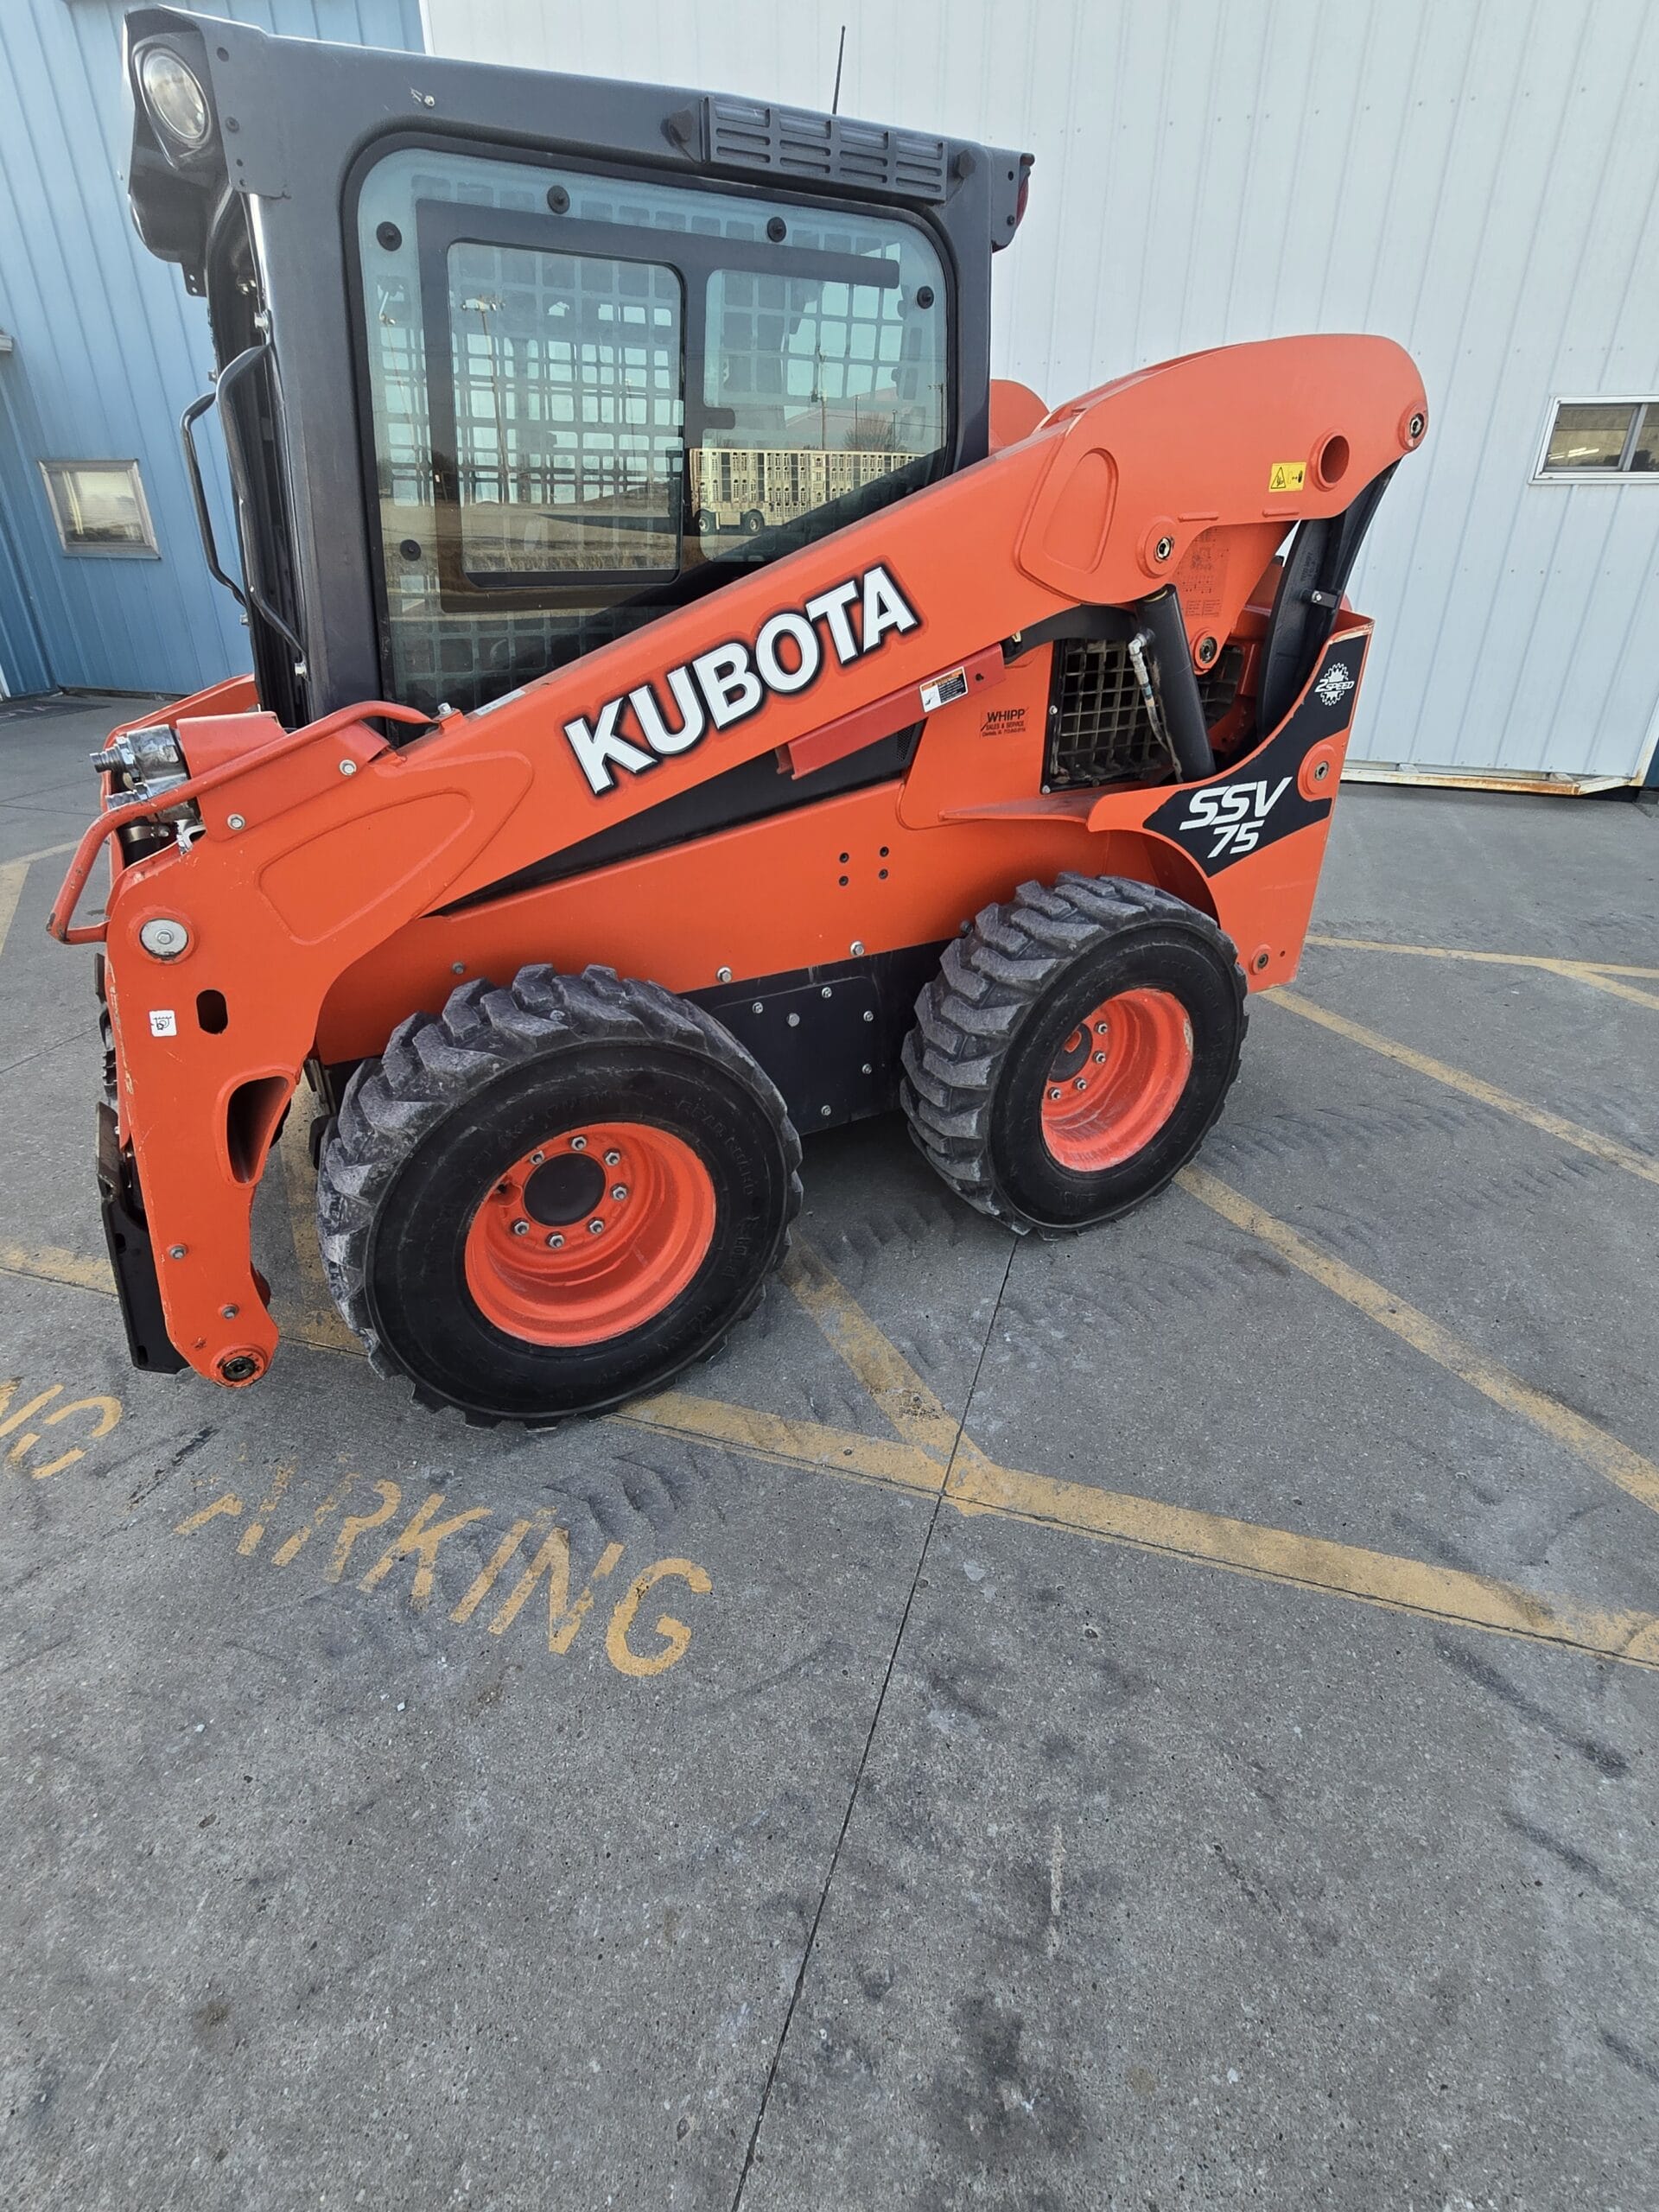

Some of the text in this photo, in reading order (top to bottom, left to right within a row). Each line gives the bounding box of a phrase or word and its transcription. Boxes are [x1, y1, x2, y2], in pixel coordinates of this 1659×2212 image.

[563, 566, 918, 795] KUBOTA
[987, 709, 1025, 723] WHIPP
[1179, 776, 1294, 831] SSV
[1207, 819, 1265, 859] 75
[171, 1445, 714, 1677] ARKING
